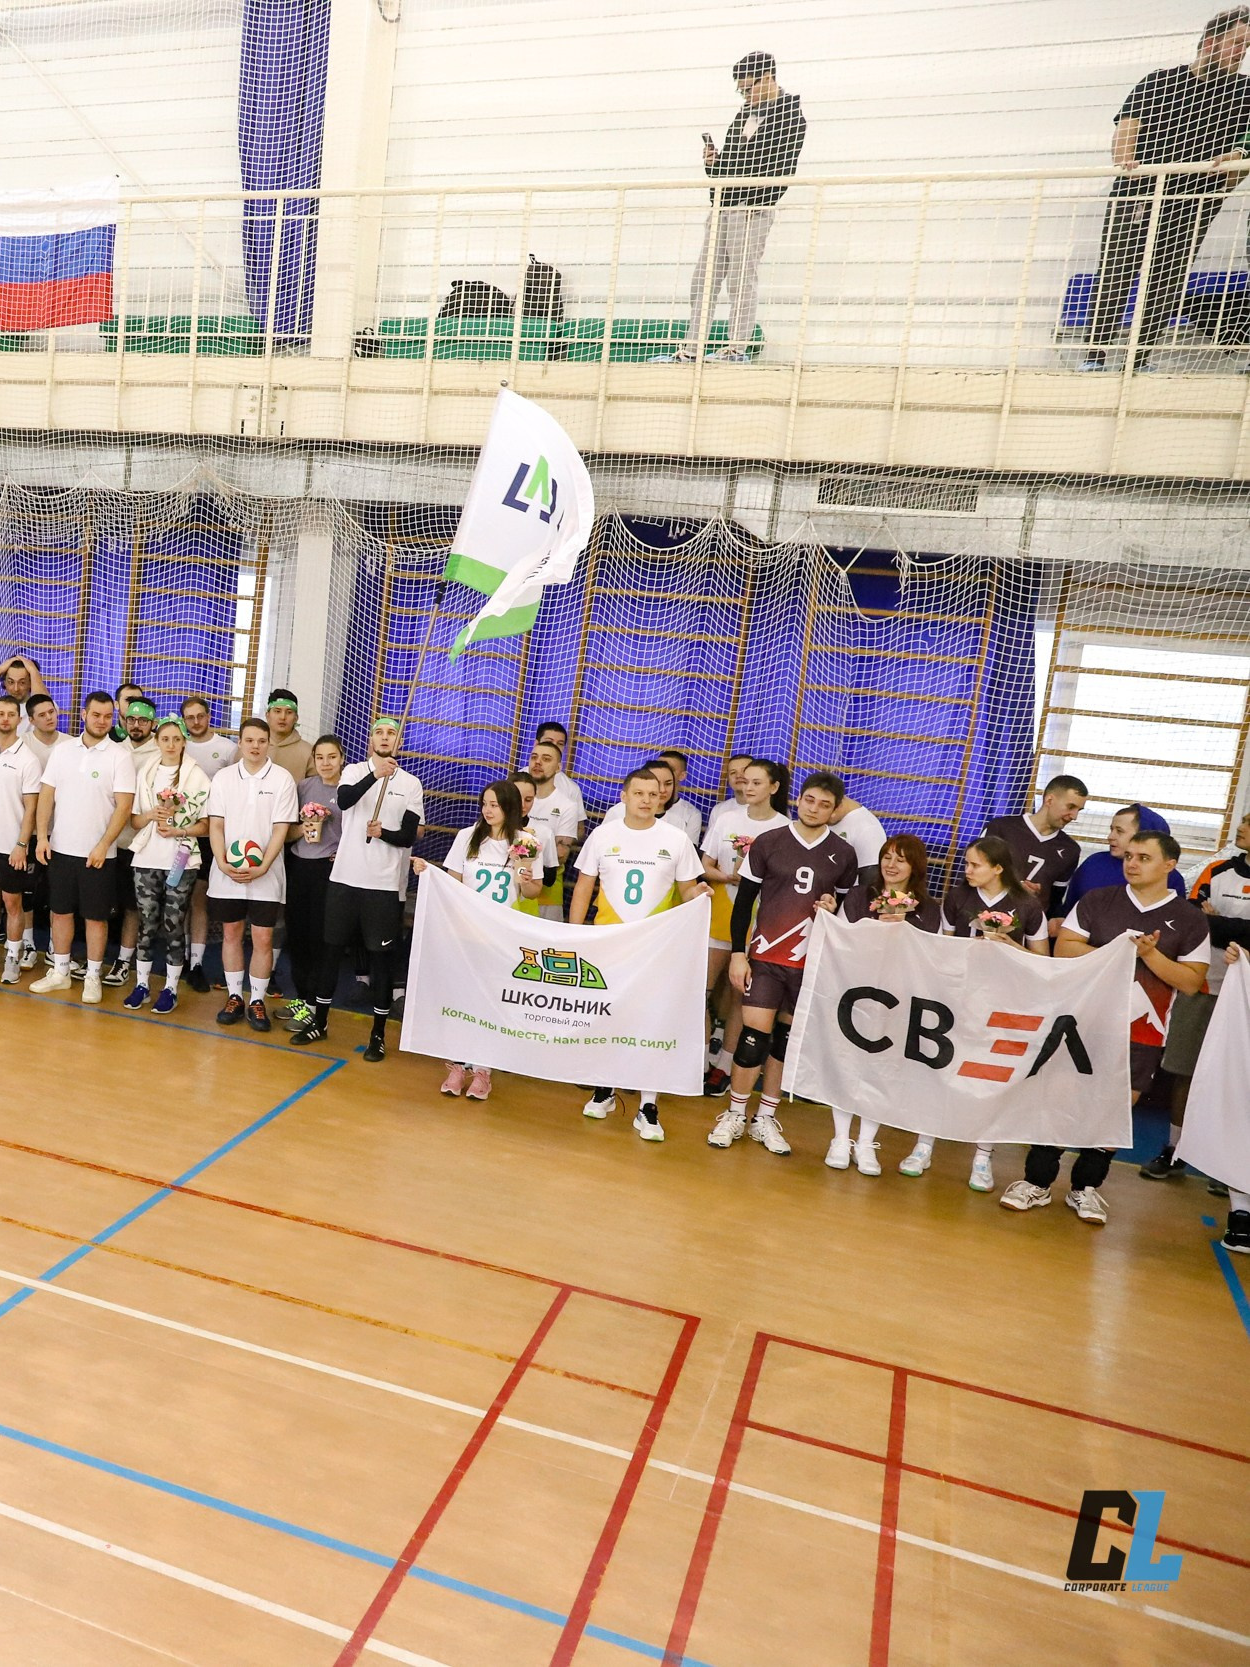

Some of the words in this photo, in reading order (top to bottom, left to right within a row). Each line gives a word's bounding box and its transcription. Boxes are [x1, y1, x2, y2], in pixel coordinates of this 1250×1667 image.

[793, 866, 815, 895] 9
[1027, 854, 1046, 881] 7
[475, 868, 512, 904] 23
[624, 868, 645, 905] 8
[501, 988, 612, 1017] ШКОЛЬНИК
[441, 1006, 476, 1024] Когда
[478, 1018, 497, 1031] мы
[500, 1025, 549, 1044] вместе,
[553, 1035, 580, 1045] нам
[584, 1035, 607, 1045] все
[611, 1035, 637, 1047] под
[640, 1038, 677, 1051] силу!
[523, 1012, 570, 1027] торговый
[572, 1019, 591, 1029] дом
